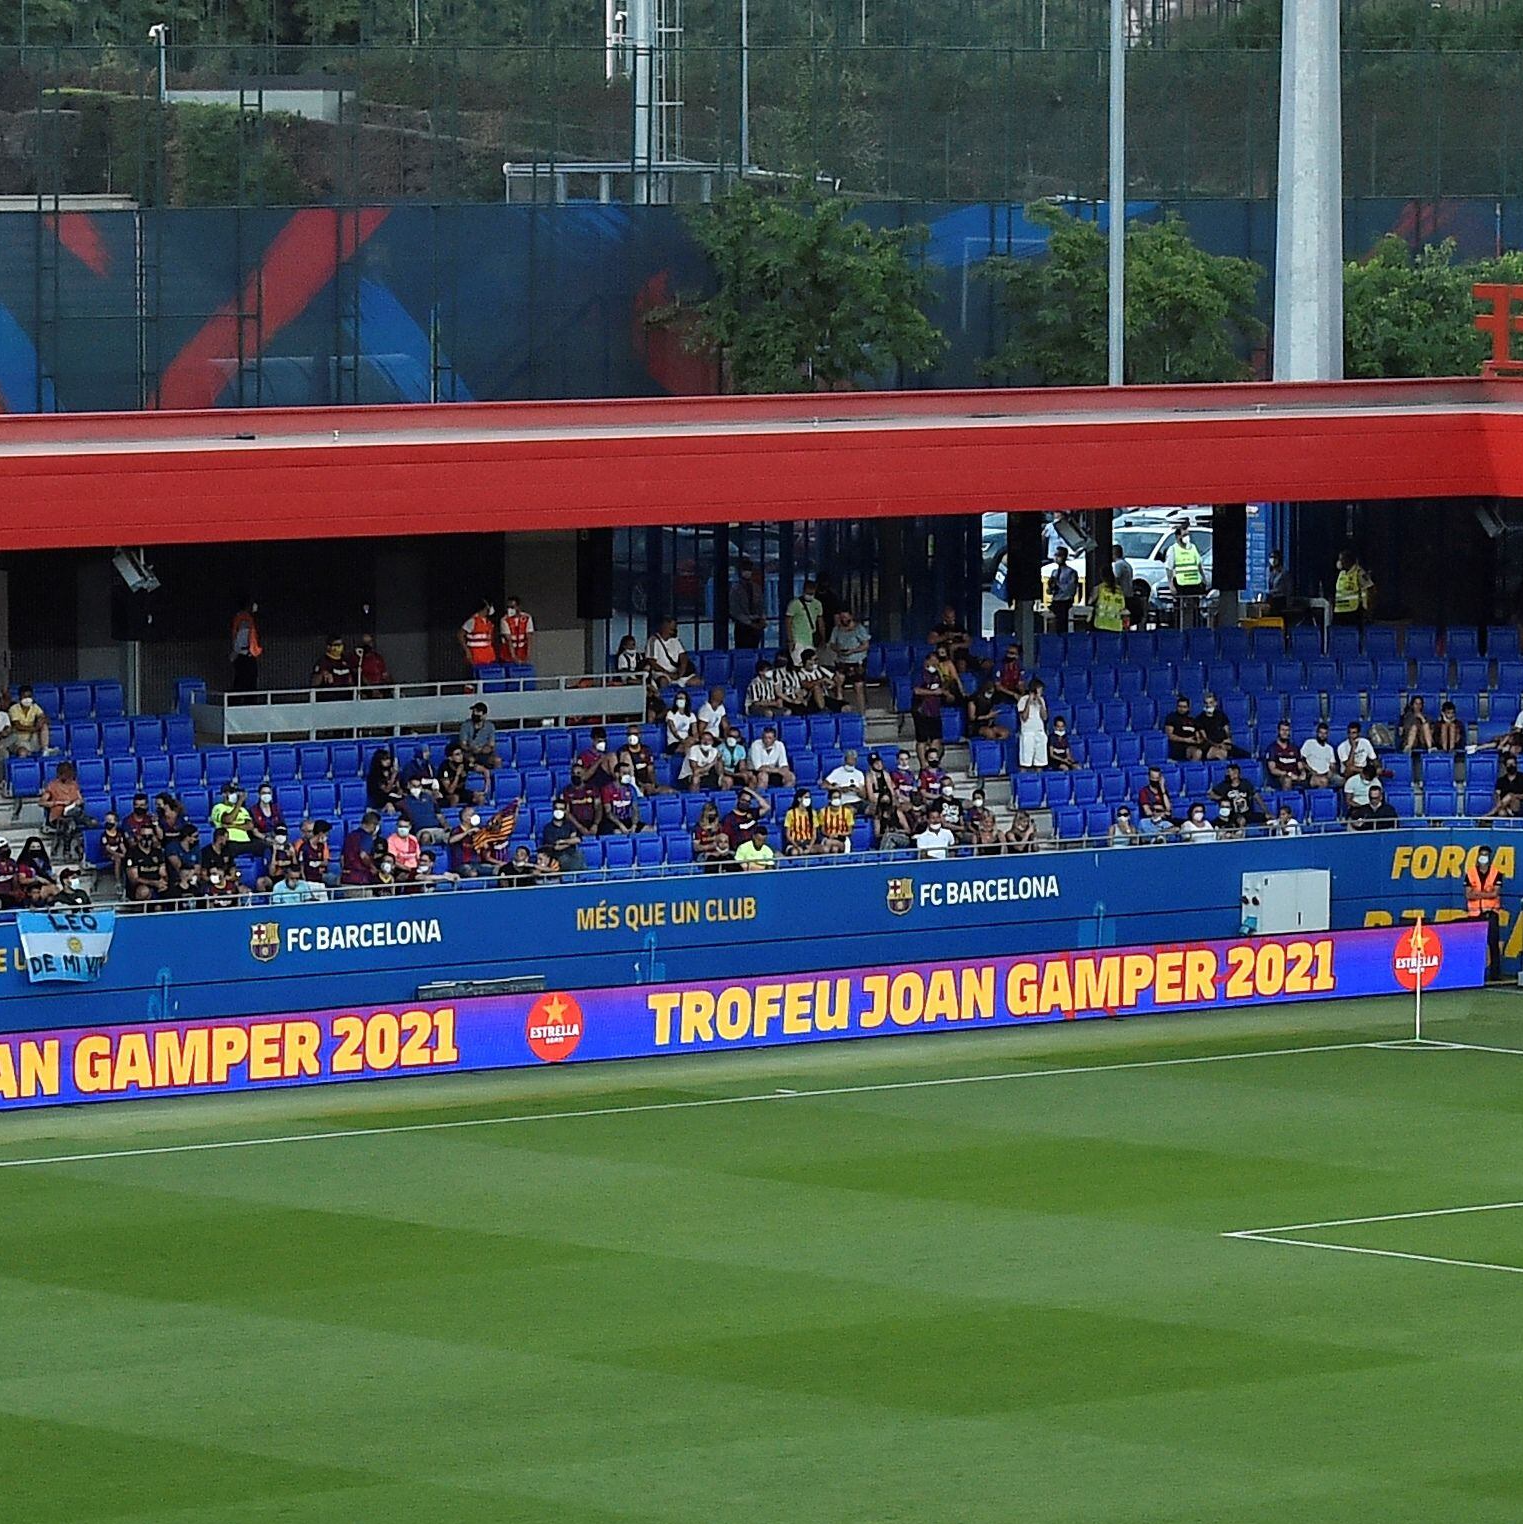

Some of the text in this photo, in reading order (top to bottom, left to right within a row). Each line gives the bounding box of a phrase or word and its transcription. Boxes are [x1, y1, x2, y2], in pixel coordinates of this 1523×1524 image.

[920, 874, 1059, 907] FC BARCELONA
[576, 896, 756, 932] MÉS QUE UN CLUB
[287, 919, 441, 952] FC BARCELONA
[648, 941, 1335, 1046] TROFEU JOAN GAMPER 2021
[528, 1024, 581, 1041] ESTRELLA
[74, 1019, 323, 1094] GAMPER
[330, 1008, 459, 1072] 2021
